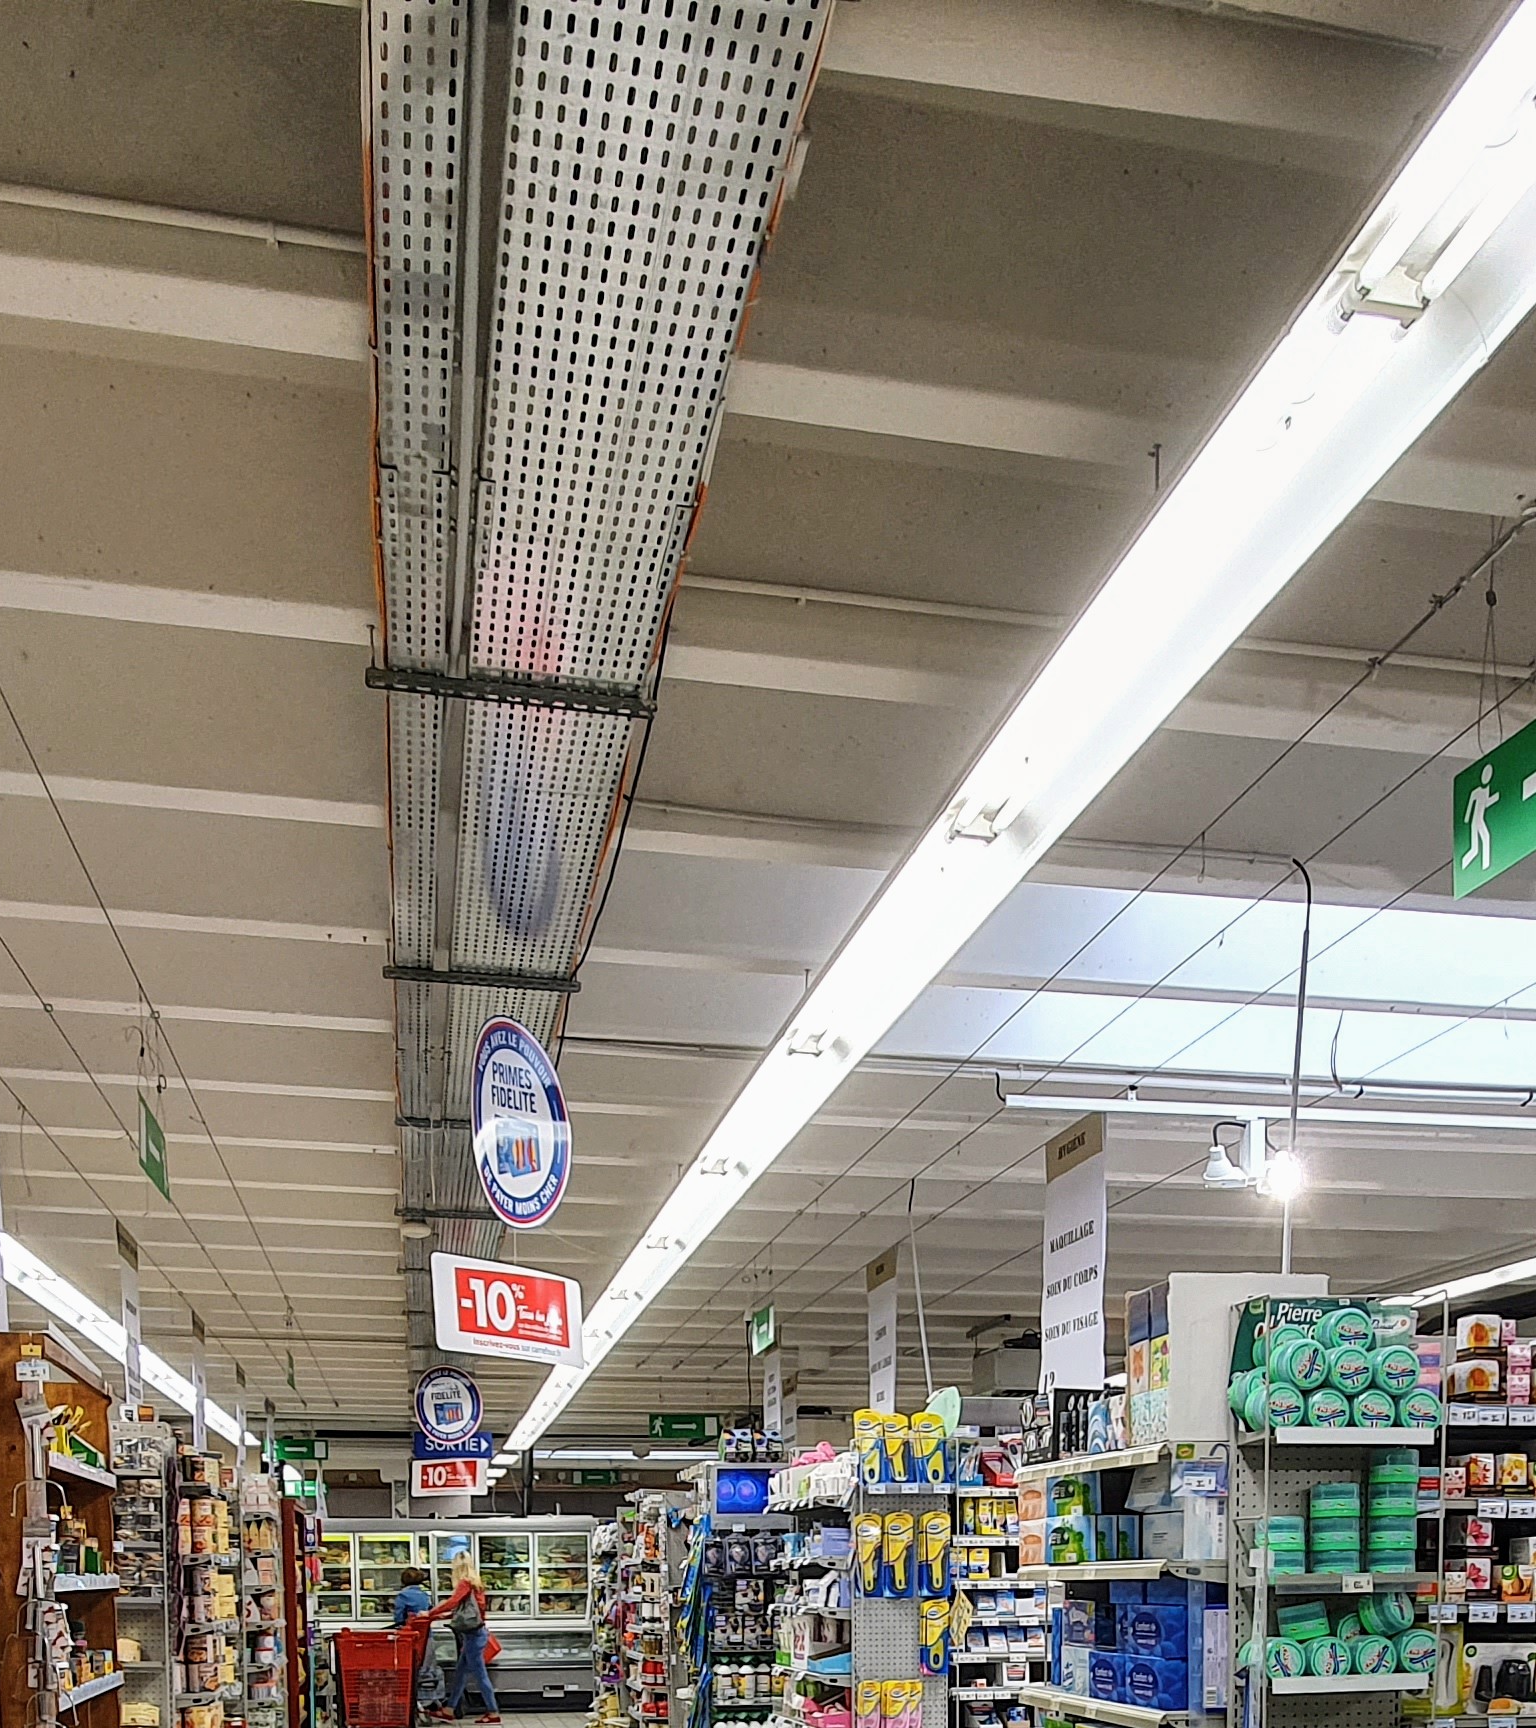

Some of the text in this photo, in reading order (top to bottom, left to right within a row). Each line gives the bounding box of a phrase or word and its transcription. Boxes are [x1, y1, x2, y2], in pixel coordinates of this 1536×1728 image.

[490, 1030, 507, 1047] AVEZ
[507, 1031, 518, 1044] LE
[518, 1037, 553, 1088] POUVOIR
[492, 1061, 532, 1090] PRIMES
[491, 1085, 537, 1114] FIDELITE
[492, 1183, 514, 1213] PAYER
[515, 1198, 541, 1216] MOINS
[541, 1173, 559, 1204] CHER
[1050, 1219, 1095, 1254] MAQUILLAGE
[1046, 1264, 1099, 1299] SOIN DU CORPS
[460, 1277, 525, 1332] -10%
[1277, 1302, 1323, 1322] Pierre
[1044, 1310, 1099, 1342] SOIN DU VISAGE
